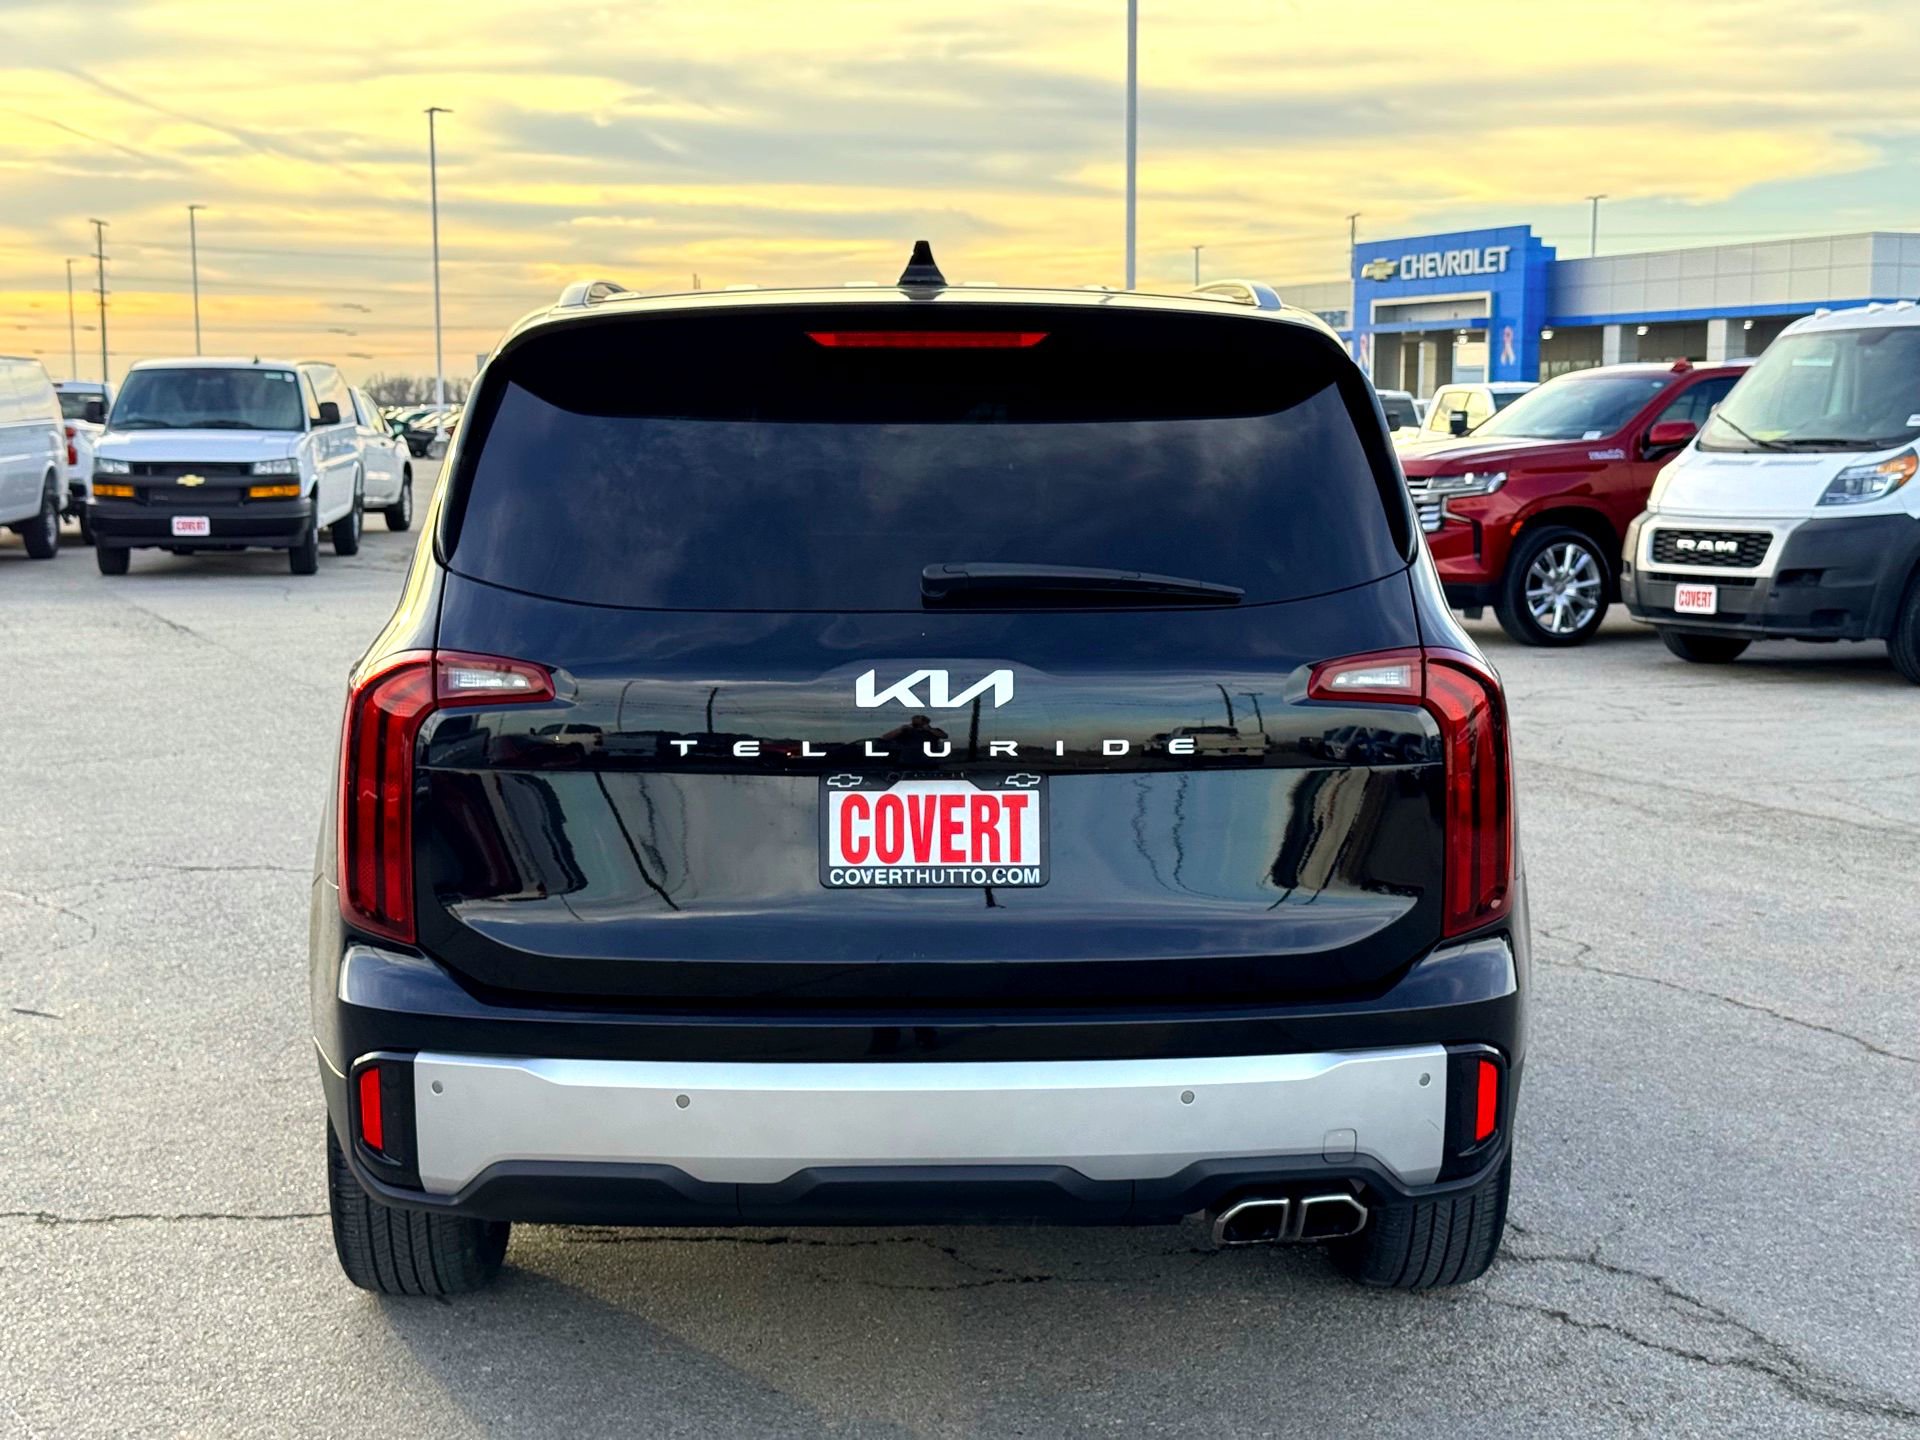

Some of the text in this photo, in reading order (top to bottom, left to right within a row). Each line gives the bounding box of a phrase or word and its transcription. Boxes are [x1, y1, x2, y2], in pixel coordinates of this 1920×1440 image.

[1401, 246, 1511, 280] CHEVROLET
[1676, 539, 1738, 554] RAM
[1679, 591, 1712, 608] COVERT
[855, 669, 1014, 708] KIA
[670, 738, 1195, 757] TELLURIDE
[840, 793, 1029, 864] COVERT
[829, 868, 1040, 885] COVERTHUTTO.COM
